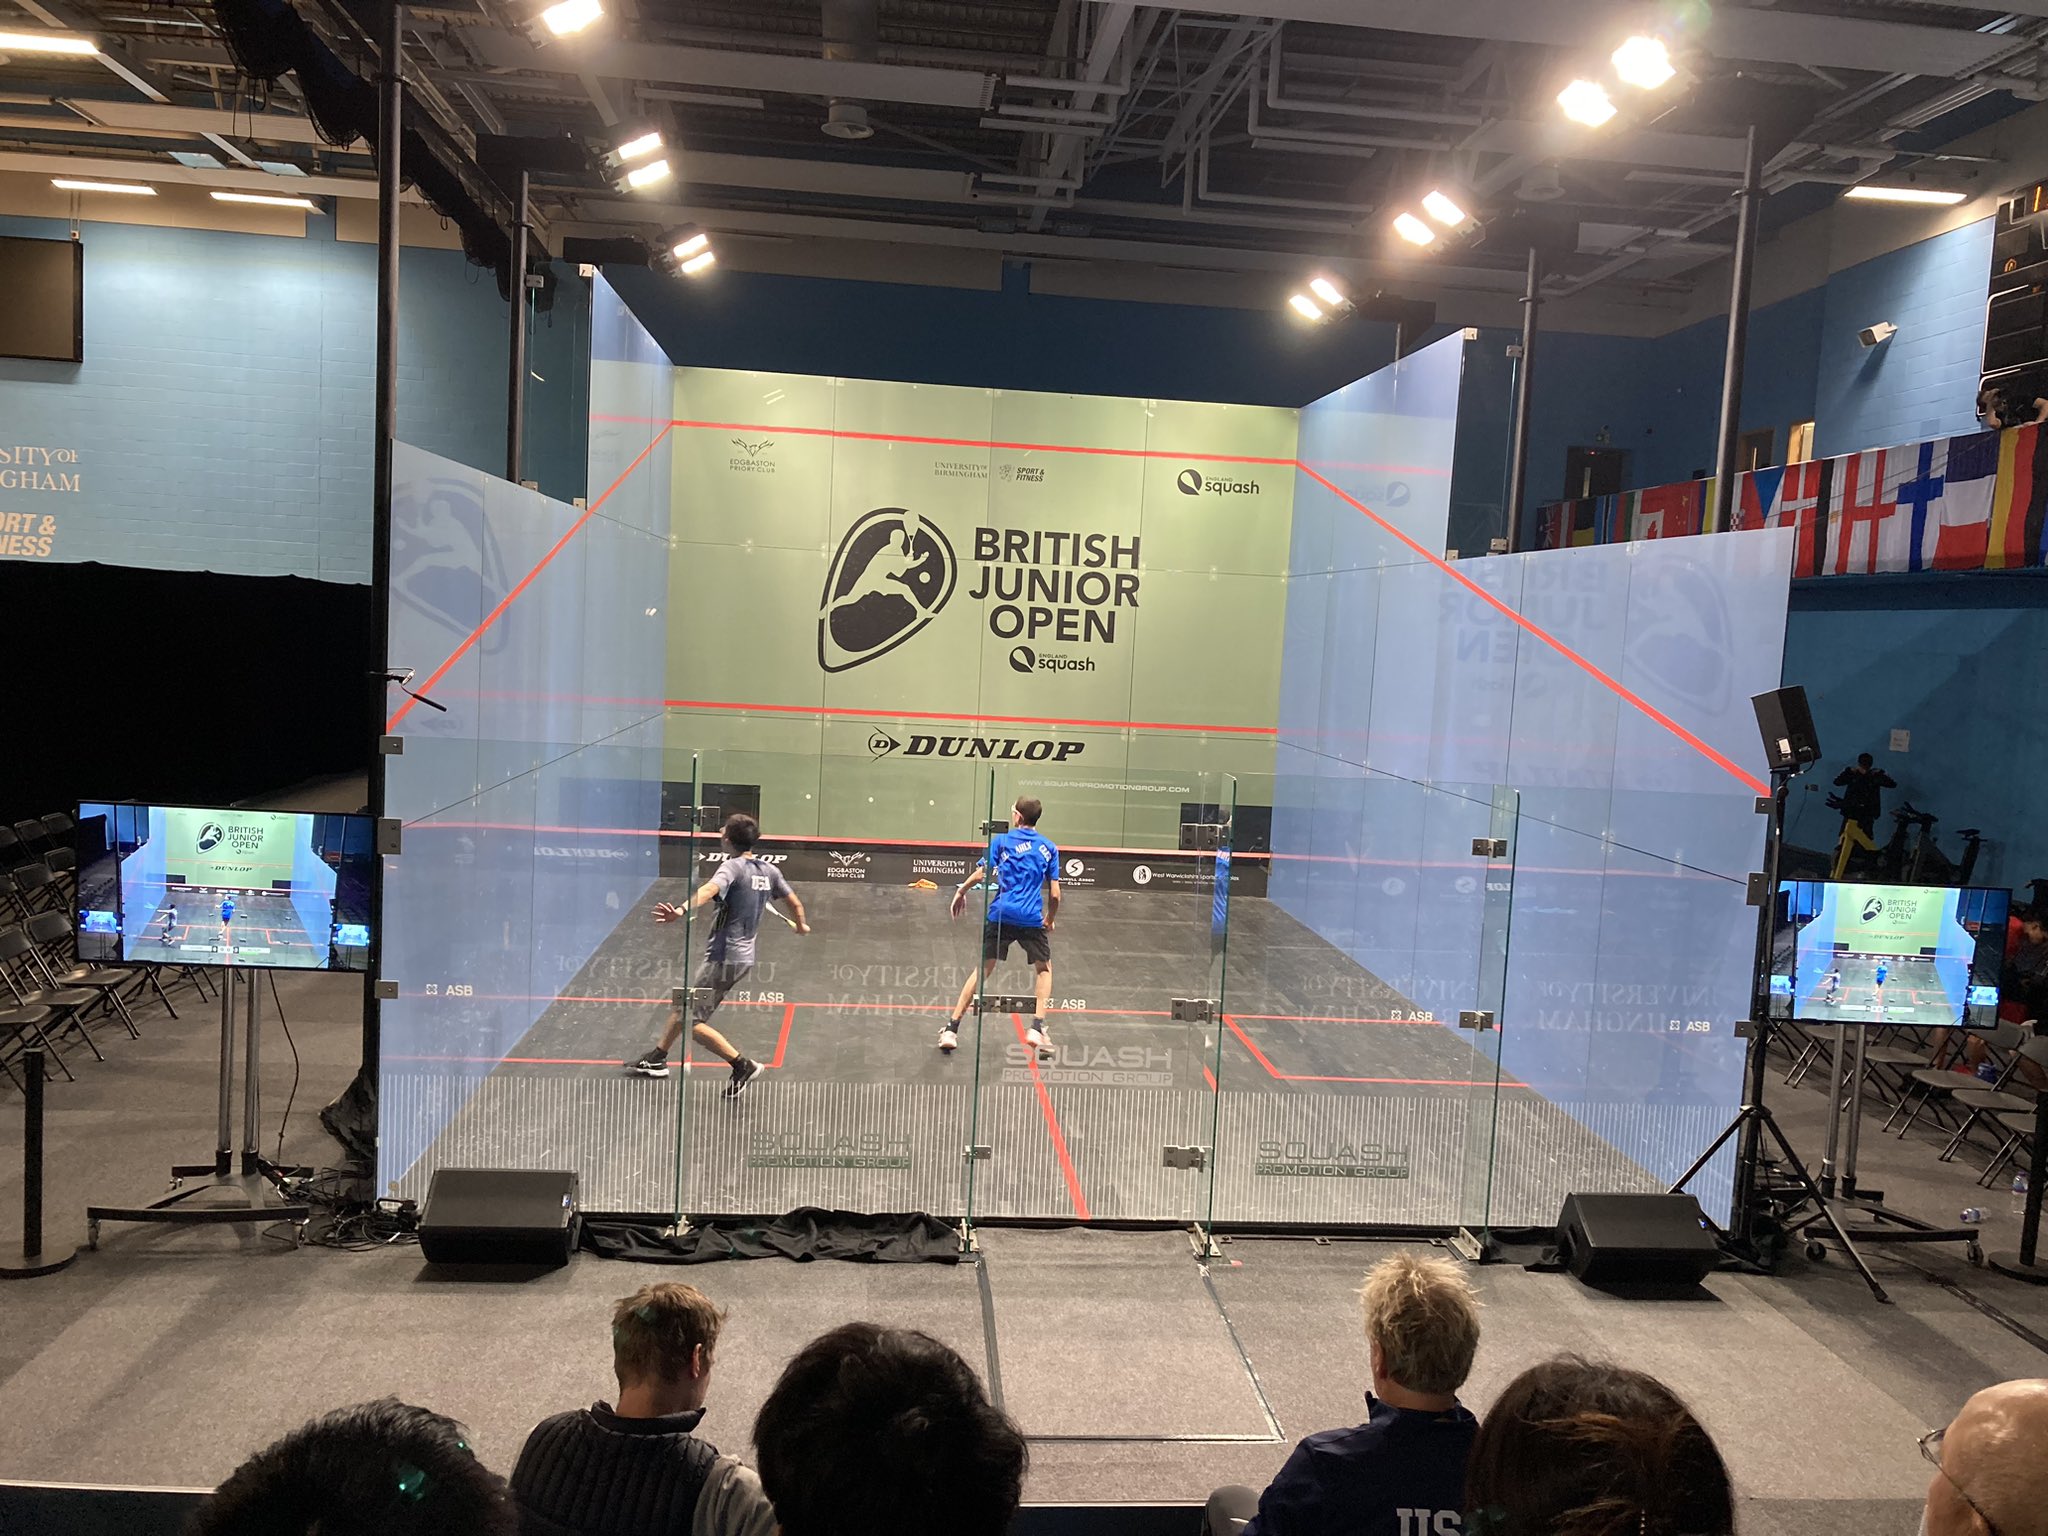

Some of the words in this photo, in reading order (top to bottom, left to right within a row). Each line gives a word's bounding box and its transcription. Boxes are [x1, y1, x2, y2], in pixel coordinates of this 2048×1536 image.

[730, 459, 775, 467] EDGBASTON
[935, 469, 988, 479] BIRMINGHAM
[1016, 467, 1039, 475] SPORT
[1016, 474, 1044, 482] FITNESS
[1204, 480, 1260, 497] squash
[38, 515, 57, 535] &
[974, 527, 1140, 570] BRITISH
[968, 565, 1140, 608] JUNIOR
[989, 604, 1116, 643] OPEN
[1038, 657, 1096, 674] squash
[903, 735, 1086, 762] DUNLOP
[228, 825, 264, 835] BRITISH
[227, 833, 264, 842] JUNIOR
[231, 840, 259, 849] OPEN
[913, 859, 958, 867] UNIVERSITY
[912, 866, 966, 875] BIRMINGHAM
[1887, 899, 1918, 907] BRITISH
[1886, 906, 1917, 914] JUNIOR
[1889, 912, 1912, 920] OPEN
[445, 985, 474, 997] ASB
[757, 991, 785, 1004] ASB
[1060, 999, 1087, 1010] ASB
[1408, 1011, 1433, 1022] ASB
[1686, 1020, 1711, 1032] ASB
[1005, 1043, 1172, 1070] SQUASH
[1003, 1069, 1104, 1083] PROMOTION
[1112, 1072, 1172, 1084] GROUP
[1259, 1141, 1408, 1162] SQUASH
[751, 1156, 846, 1167] PROMOTION
[853, 1157, 910, 1168] GROUP
[1256, 1163, 1347, 1176] PROMOTION
[1354, 1166, 1408, 1178] GROUP
